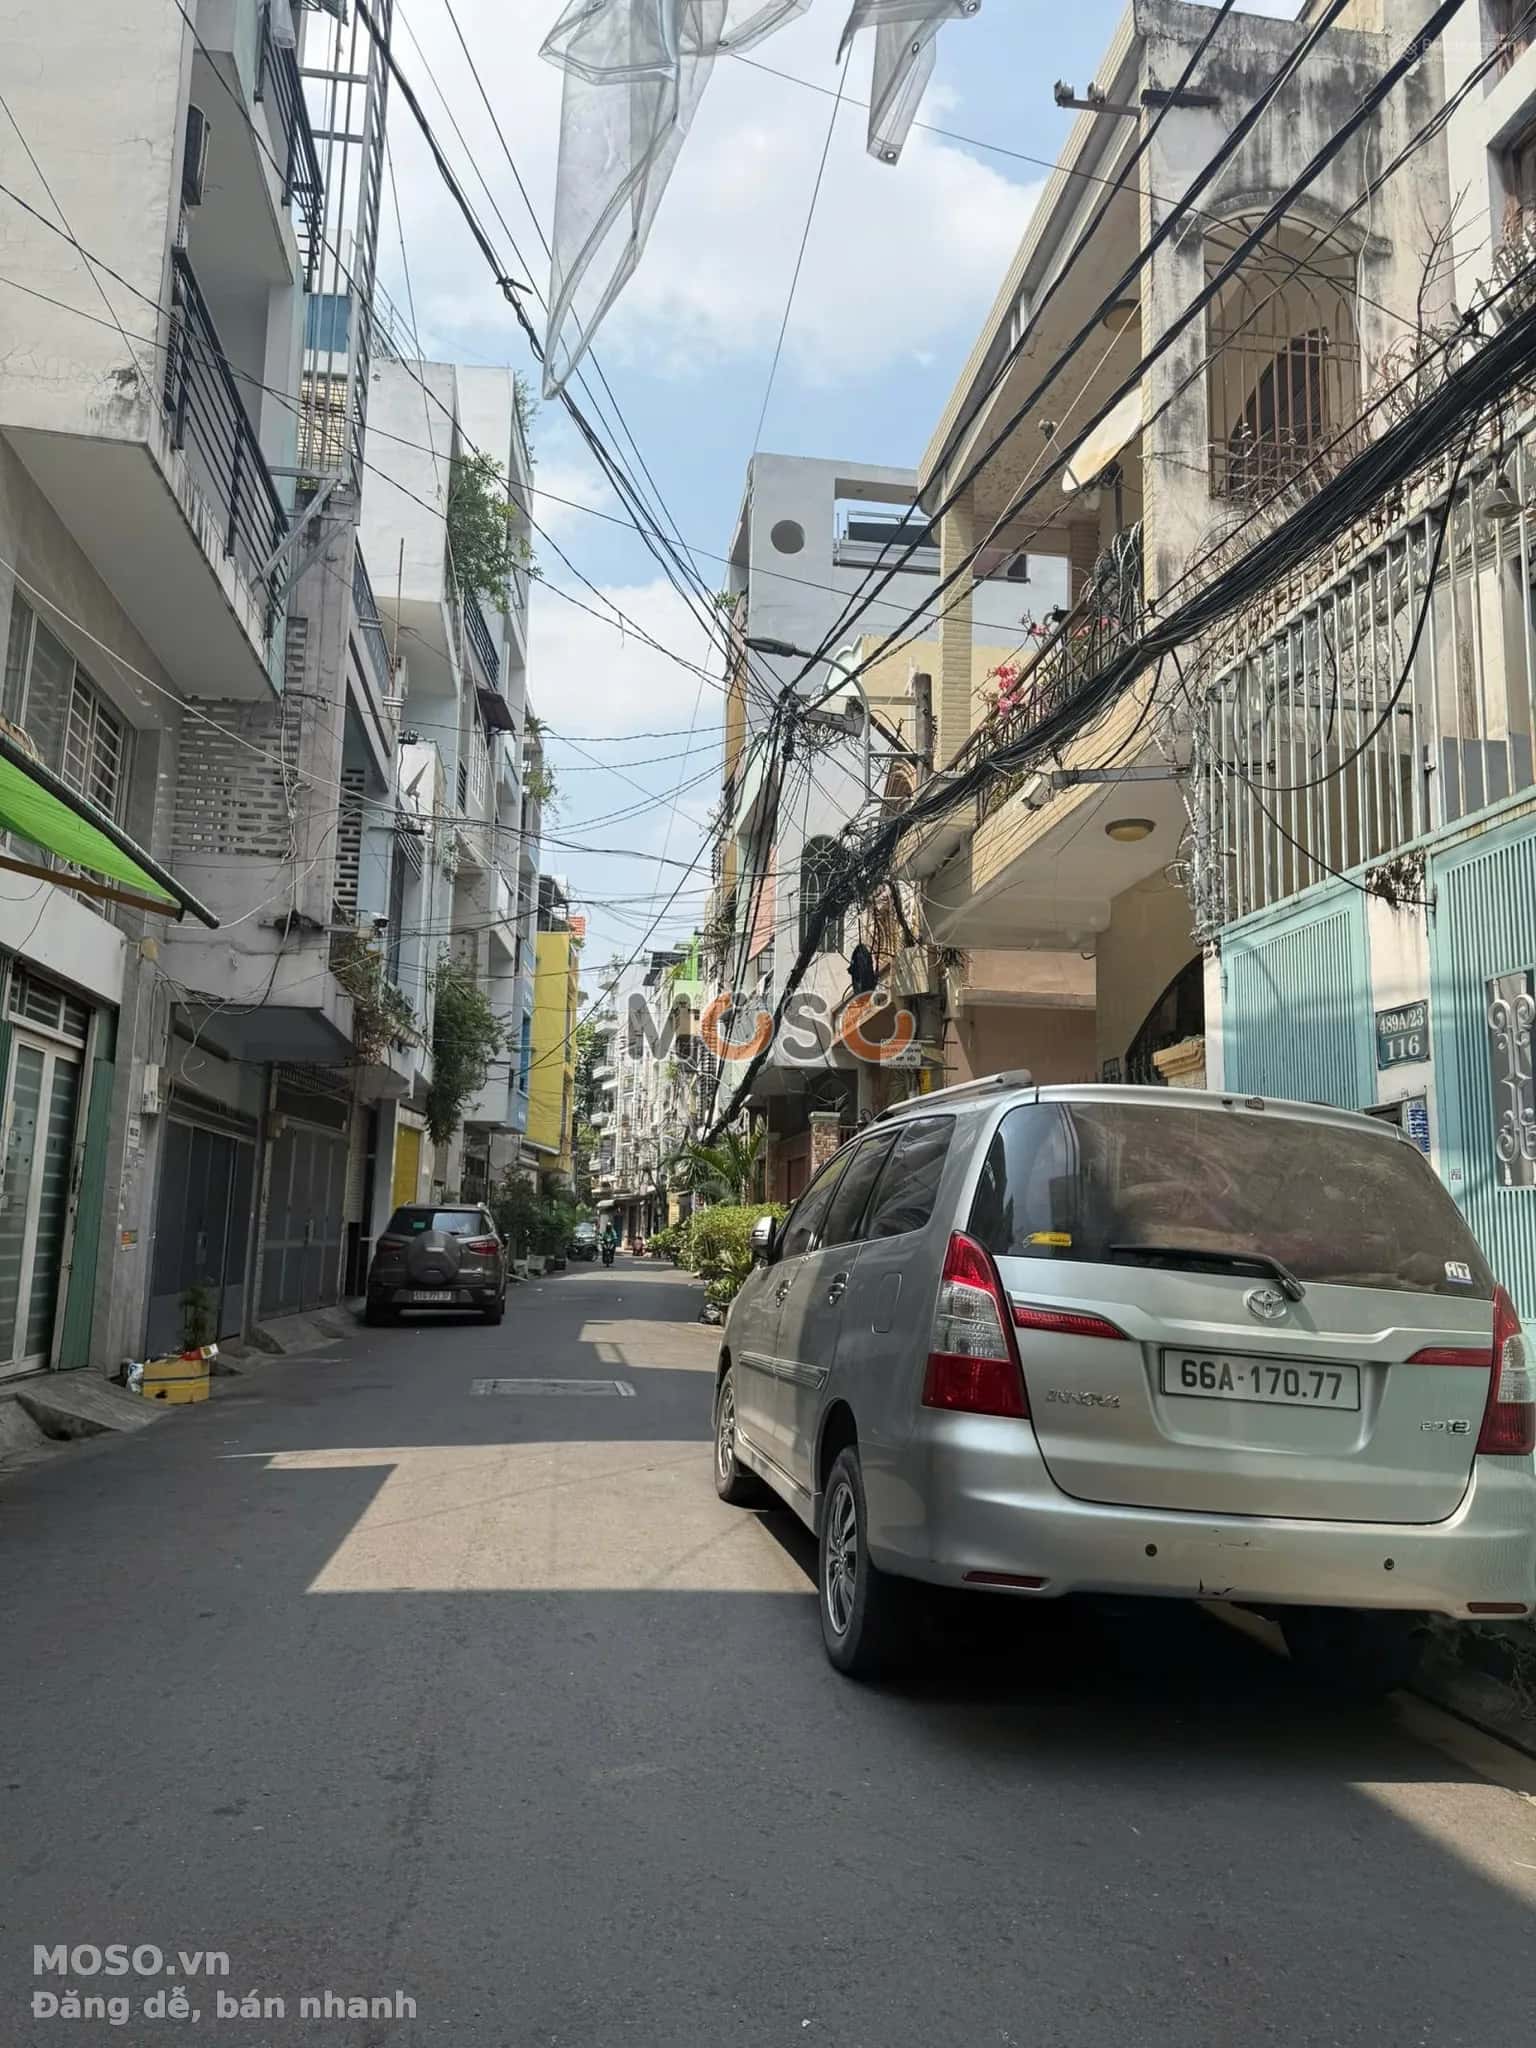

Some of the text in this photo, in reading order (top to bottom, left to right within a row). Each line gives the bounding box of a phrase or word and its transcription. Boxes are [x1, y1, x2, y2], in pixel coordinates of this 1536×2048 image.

[1379, 1007, 1425, 1035] 489A/23
[1387, 1035, 1420, 1060] 116
[1181, 1359, 1343, 1401] 66A-170.77
